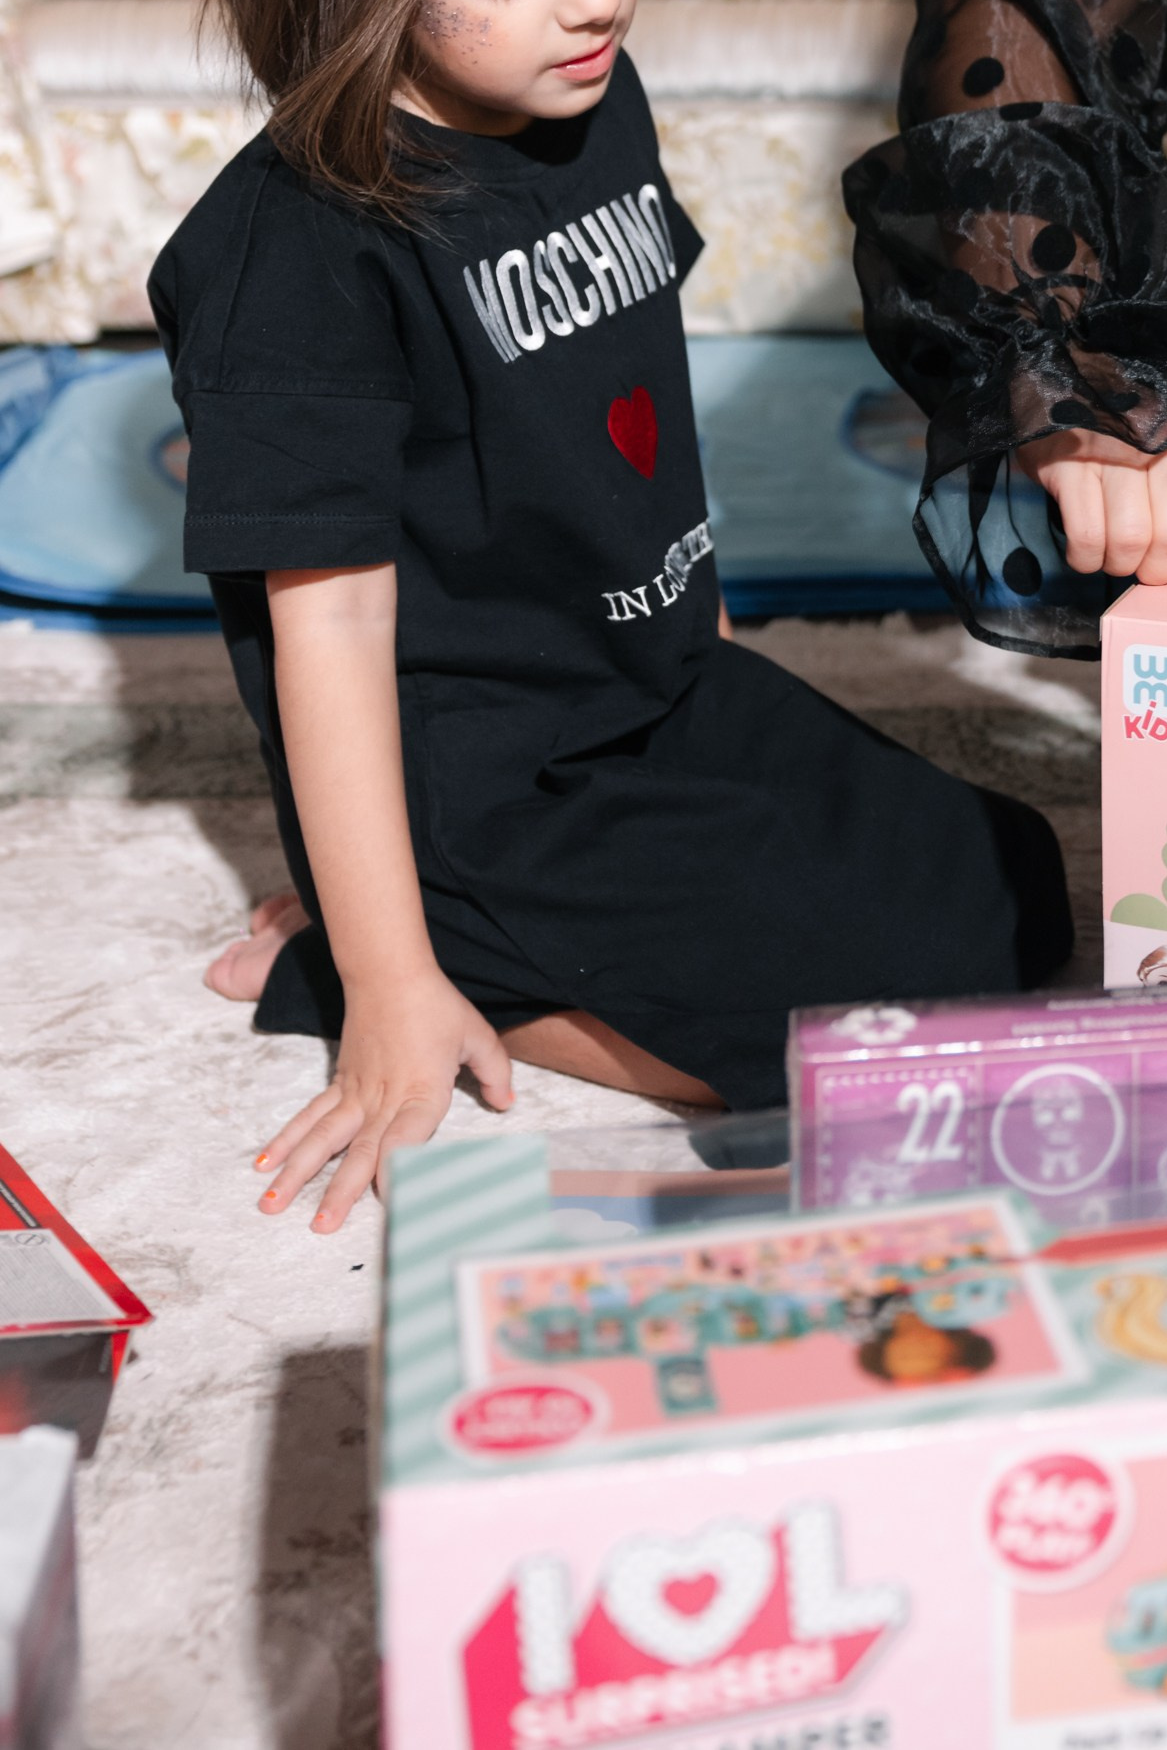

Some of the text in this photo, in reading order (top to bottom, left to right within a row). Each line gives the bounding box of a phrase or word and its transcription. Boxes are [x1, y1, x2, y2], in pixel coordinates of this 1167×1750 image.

[463, 184, 676, 363] MOSCHINO
[601, 591, 652, 621] IN
[897, 1080, 966, 1163] 22
